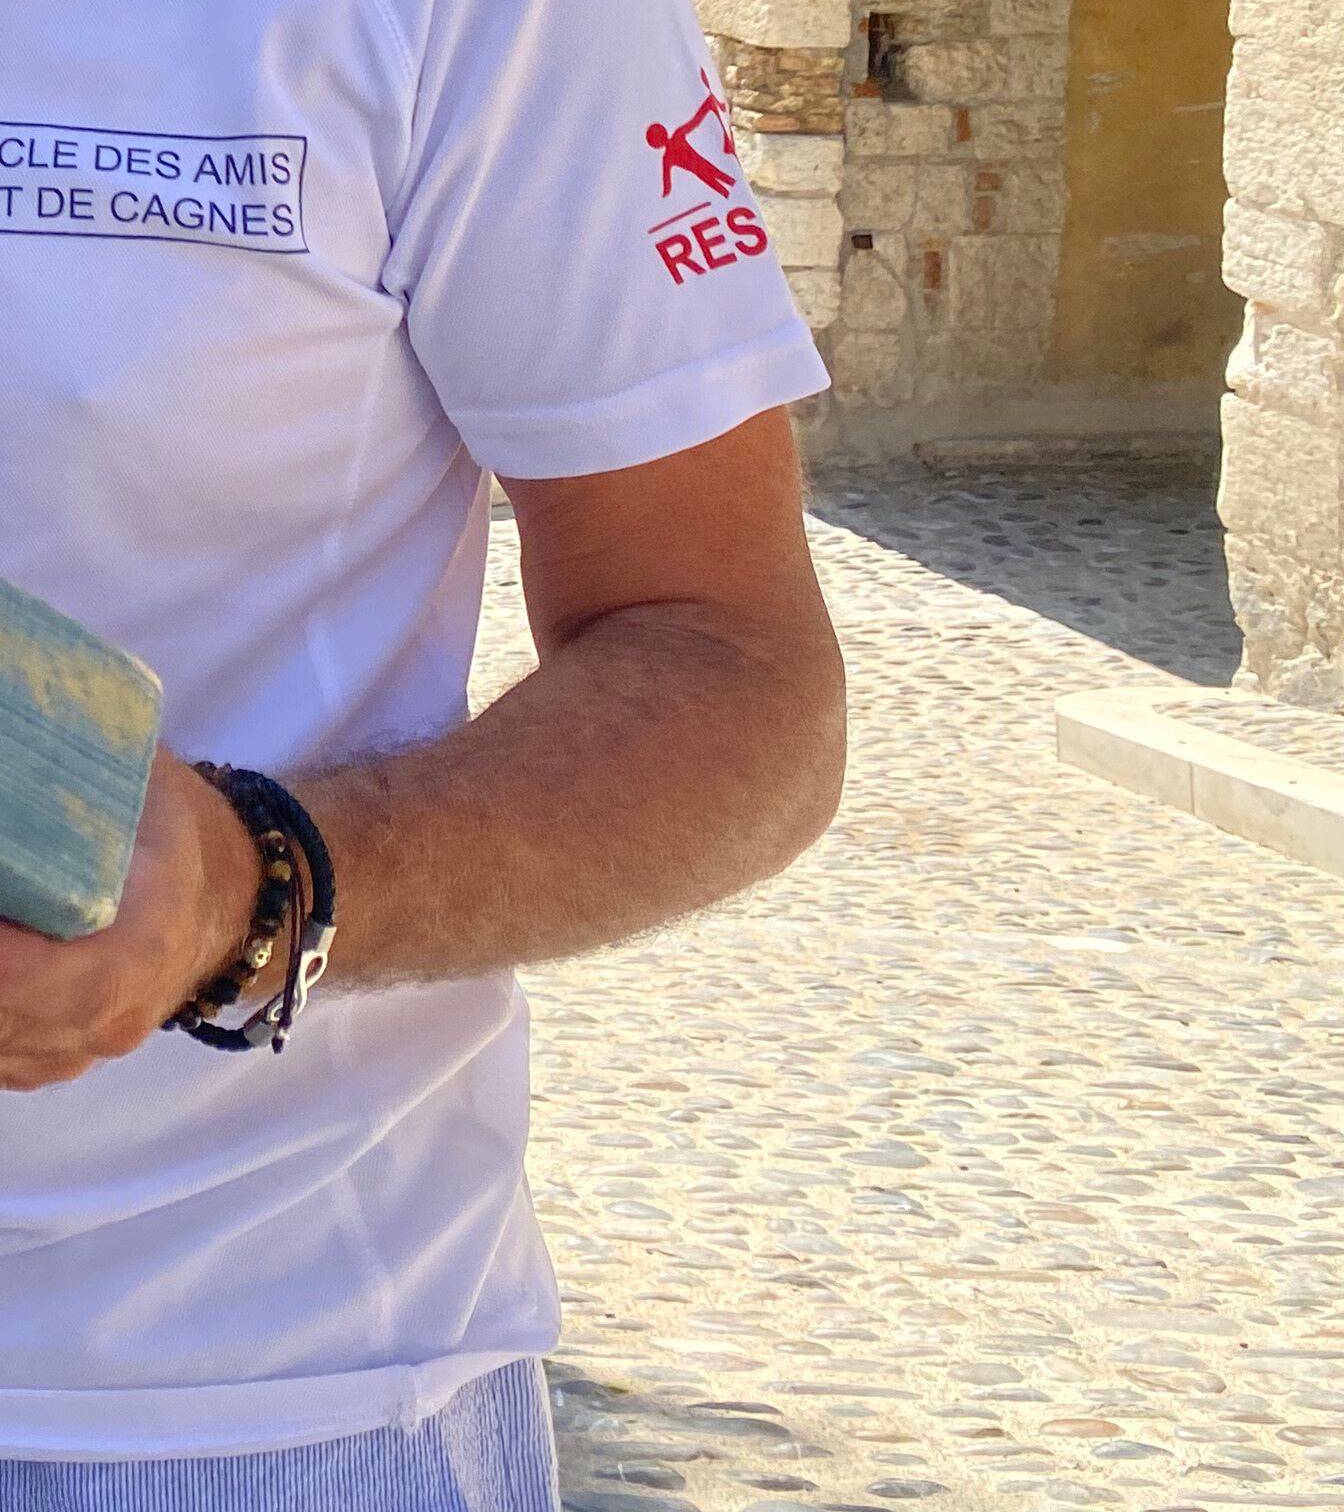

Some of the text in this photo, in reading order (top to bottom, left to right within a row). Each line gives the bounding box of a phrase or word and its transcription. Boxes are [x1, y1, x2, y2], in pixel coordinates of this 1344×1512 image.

[94, 144, 181, 180] DES
[193, 152, 292, 186] AMIS
[37, 187, 95, 220] DE
[111, 191, 295, 237] CAGNES
[655, 207, 769, 286] RES
